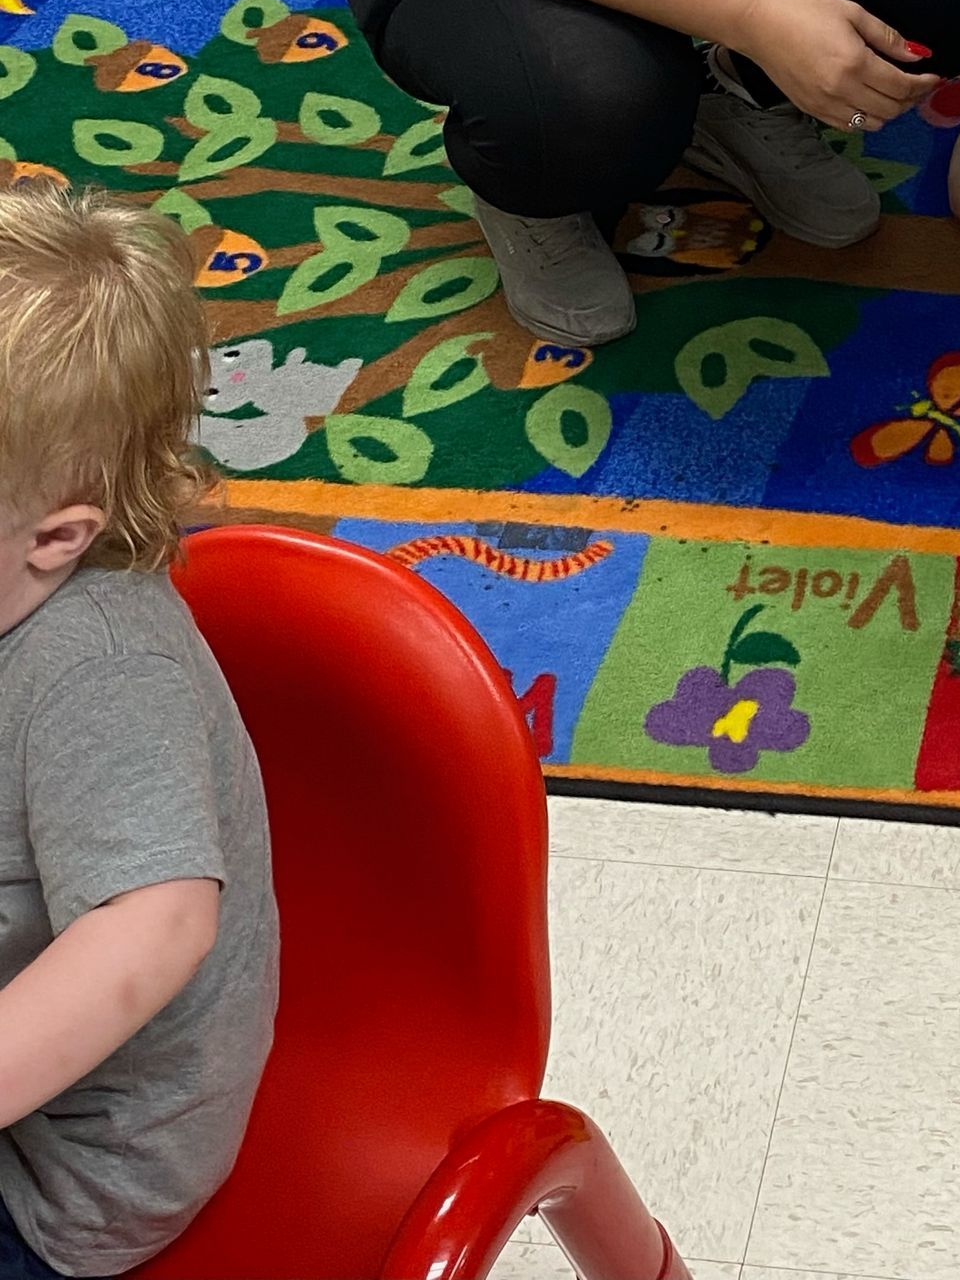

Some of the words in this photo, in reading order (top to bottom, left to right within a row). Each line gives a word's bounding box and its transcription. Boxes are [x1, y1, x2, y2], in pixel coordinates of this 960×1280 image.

[296, 32, 338, 51] 9
[135, 62, 181, 79] 8
[208, 251, 262, 274] 5
[535, 344, 585, 368] 3
[726, 555, 921, 631] Violet
